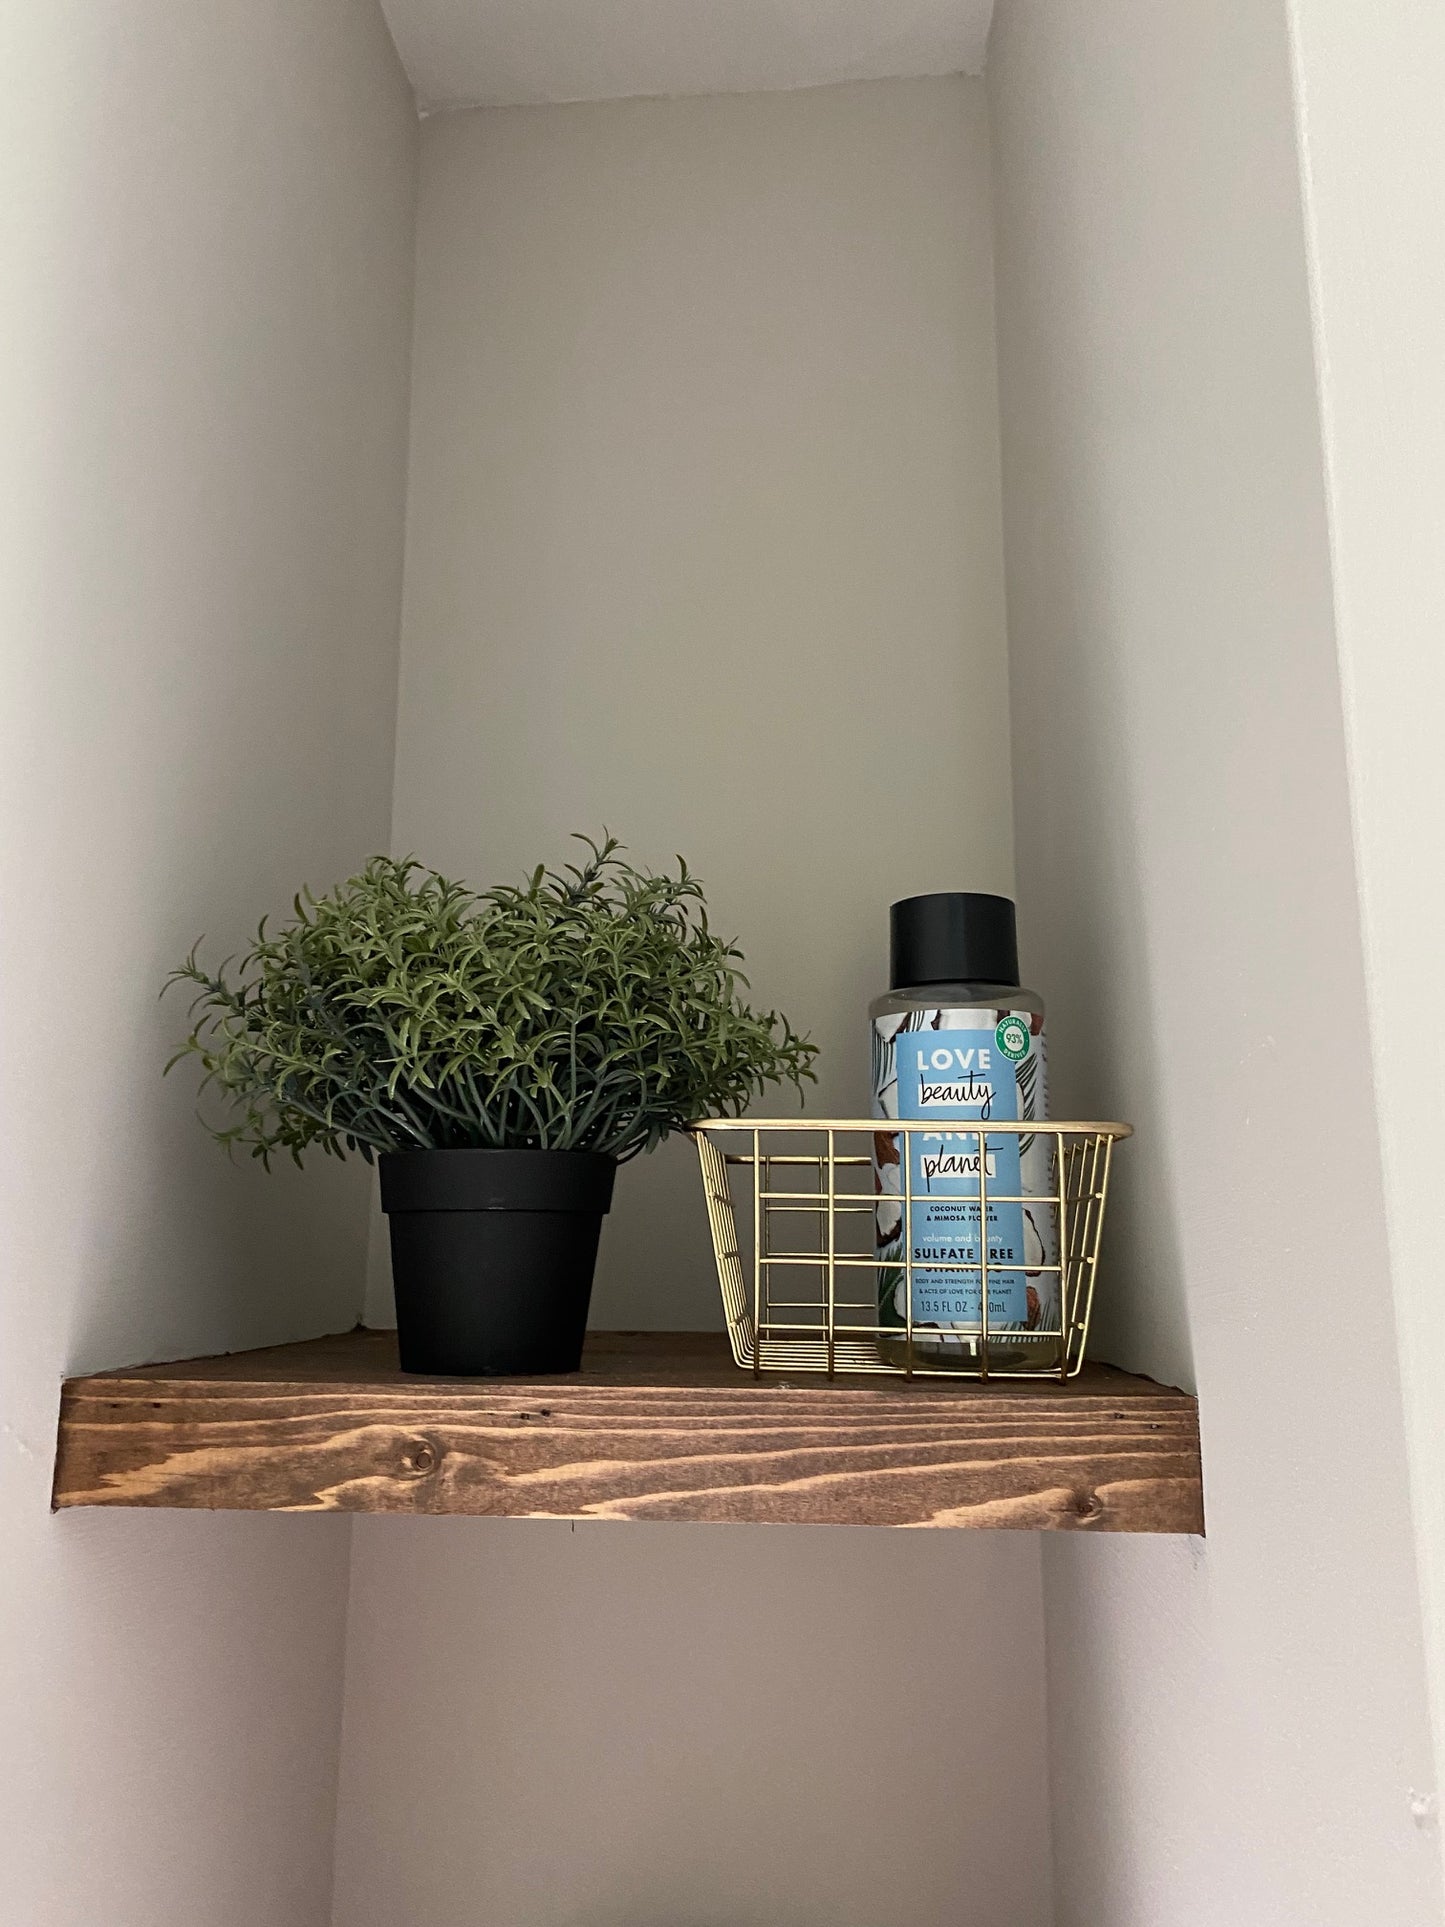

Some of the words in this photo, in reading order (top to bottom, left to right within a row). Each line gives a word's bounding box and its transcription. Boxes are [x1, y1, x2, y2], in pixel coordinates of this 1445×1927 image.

[1005, 1033, 1023, 1045] 93%
[917, 1048, 991, 1071] LOVE
[920, 1070, 997, 1121] beauty
[922, 1234, 952, 1242] volume
[954, 1232, 972, 1242] and
[914, 1248, 974, 1259] SULFATE
[987, 1248, 1014, 1260] REE
[921, 1302, 939, 1312] 13.5
[942, 1302, 952, 1312] FL
[955, 1302, 968, 1312] OZ
